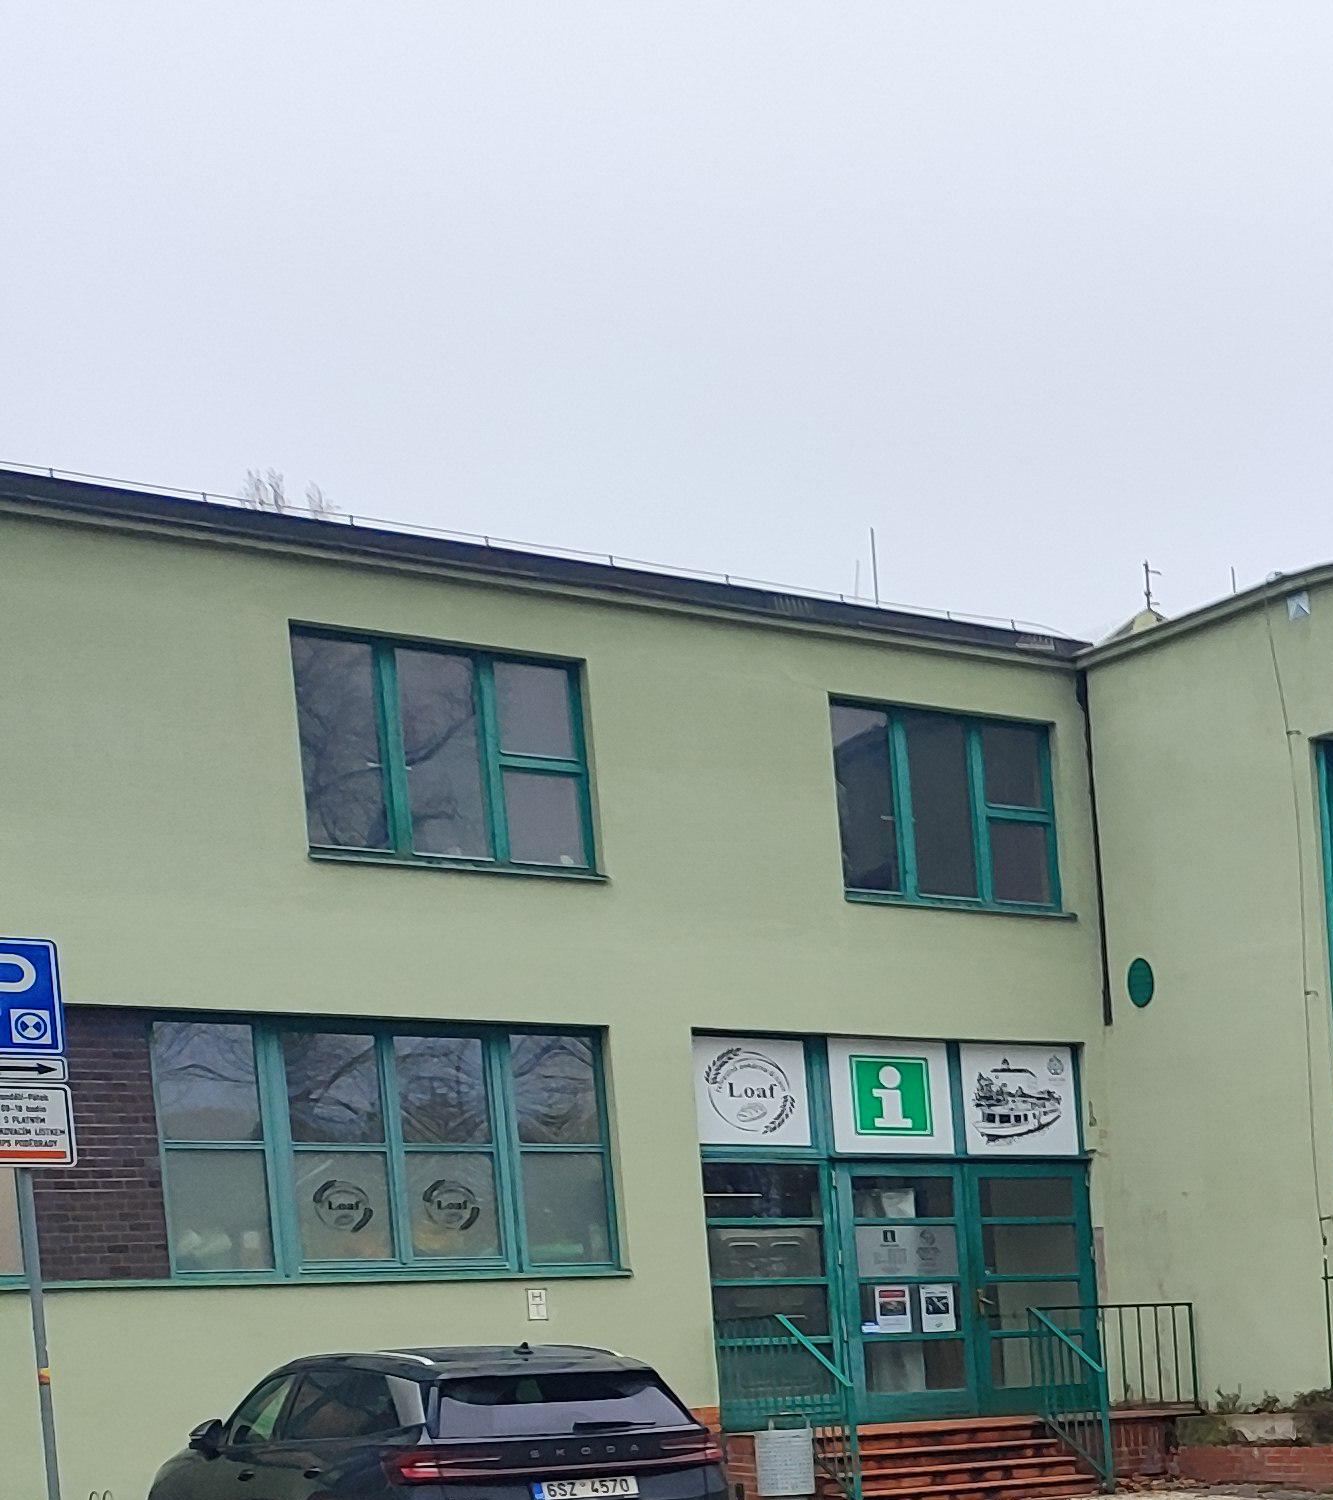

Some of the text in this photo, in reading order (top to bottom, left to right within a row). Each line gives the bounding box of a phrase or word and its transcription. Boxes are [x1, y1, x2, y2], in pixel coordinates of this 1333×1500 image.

[728, 1082, 778, 1098] Loaf
[547, 1478, 629, 1498] 6SZ 4570
